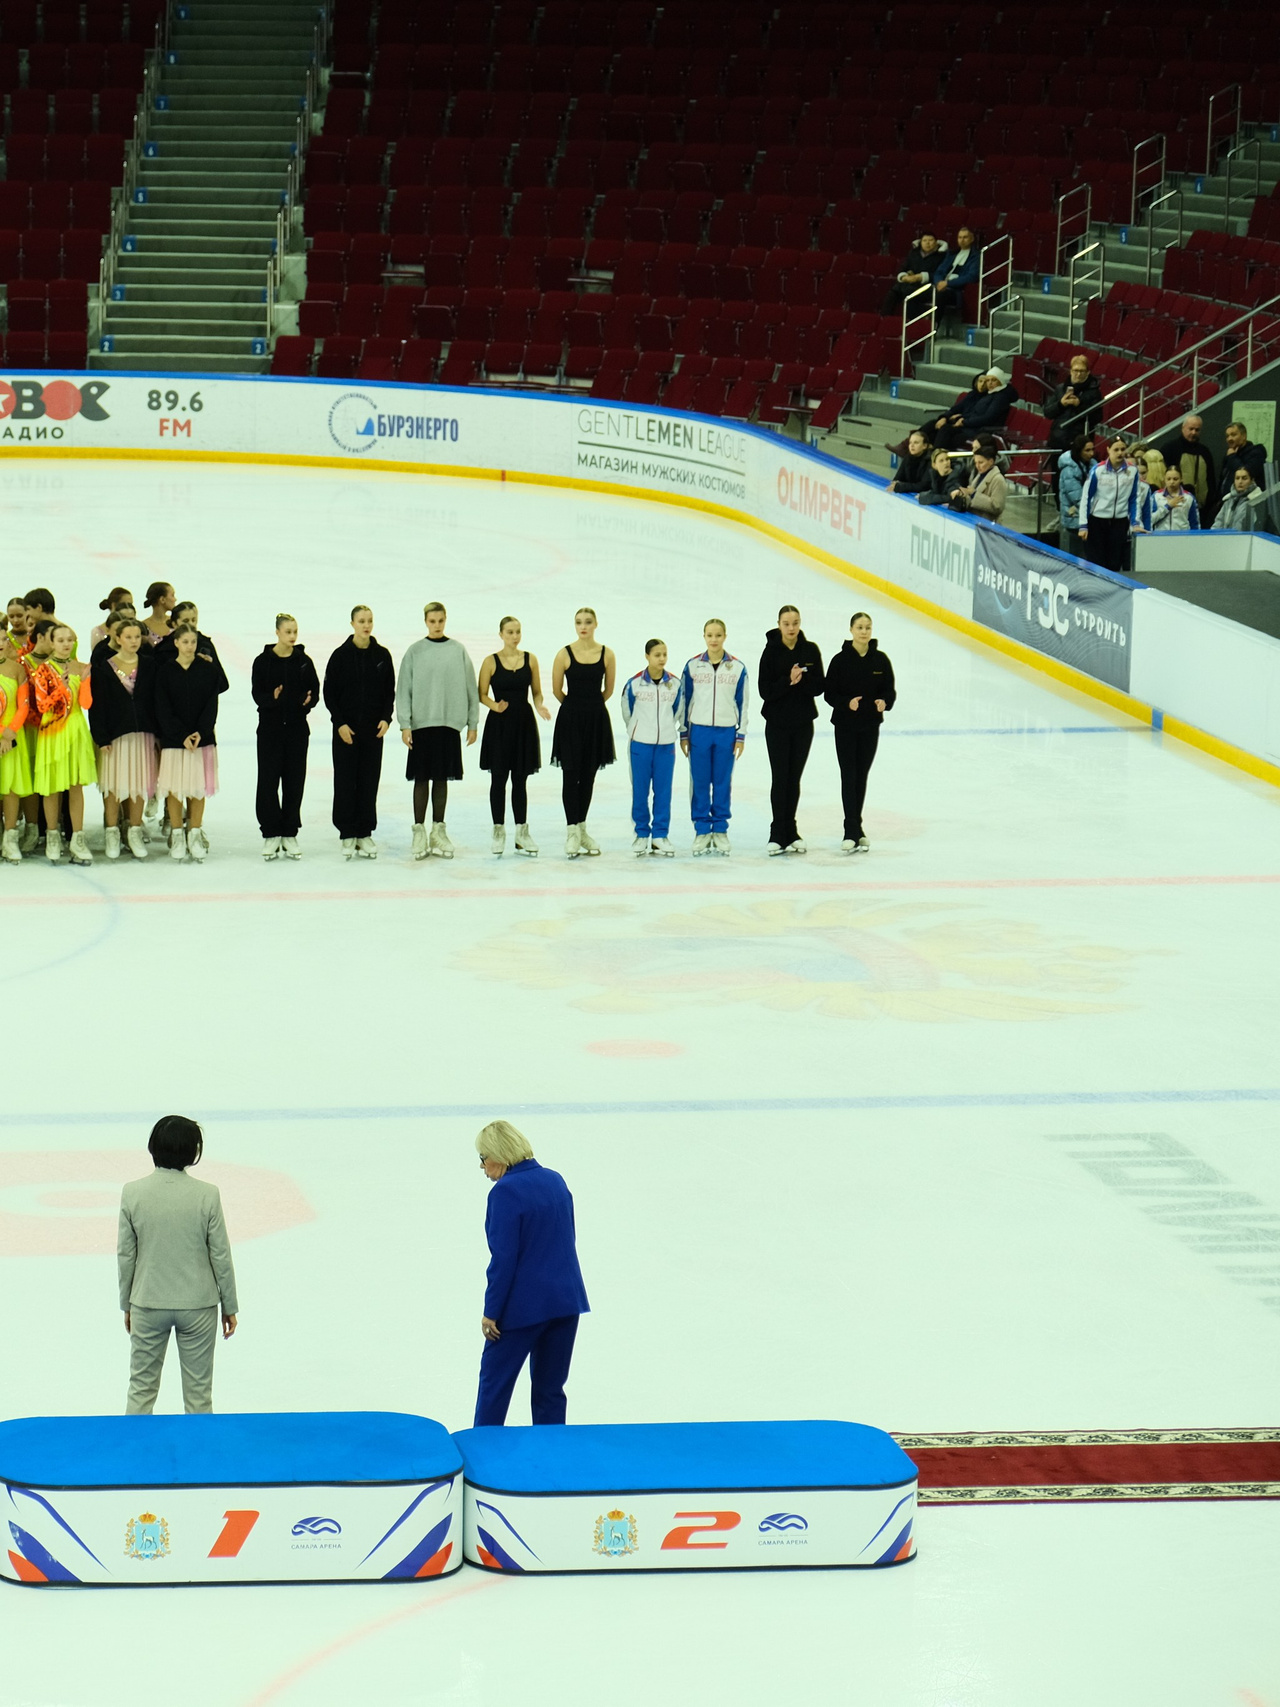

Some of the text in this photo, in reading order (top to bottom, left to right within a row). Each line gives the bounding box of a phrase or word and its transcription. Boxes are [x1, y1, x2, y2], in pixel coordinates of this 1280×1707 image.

[147, 389, 204, 412] 89.6
[158, 418, 192, 438] FM
[377, 413, 459, 442] БУРЭНЕРГО
[577, 408, 747, 464] GENTLEMEN LEAGUE
[577, 452, 746, 500] МАГАЗИН МУЖСКИХ КОСТЮМОВ
[777, 466, 867, 541] OLIMPBET
[977, 564, 1126, 647] ЭНЕРГИЯ ГЭС СТРОИТЬ
[207, 1510, 260, 1558] 1
[660, 1511, 742, 1550] 2
